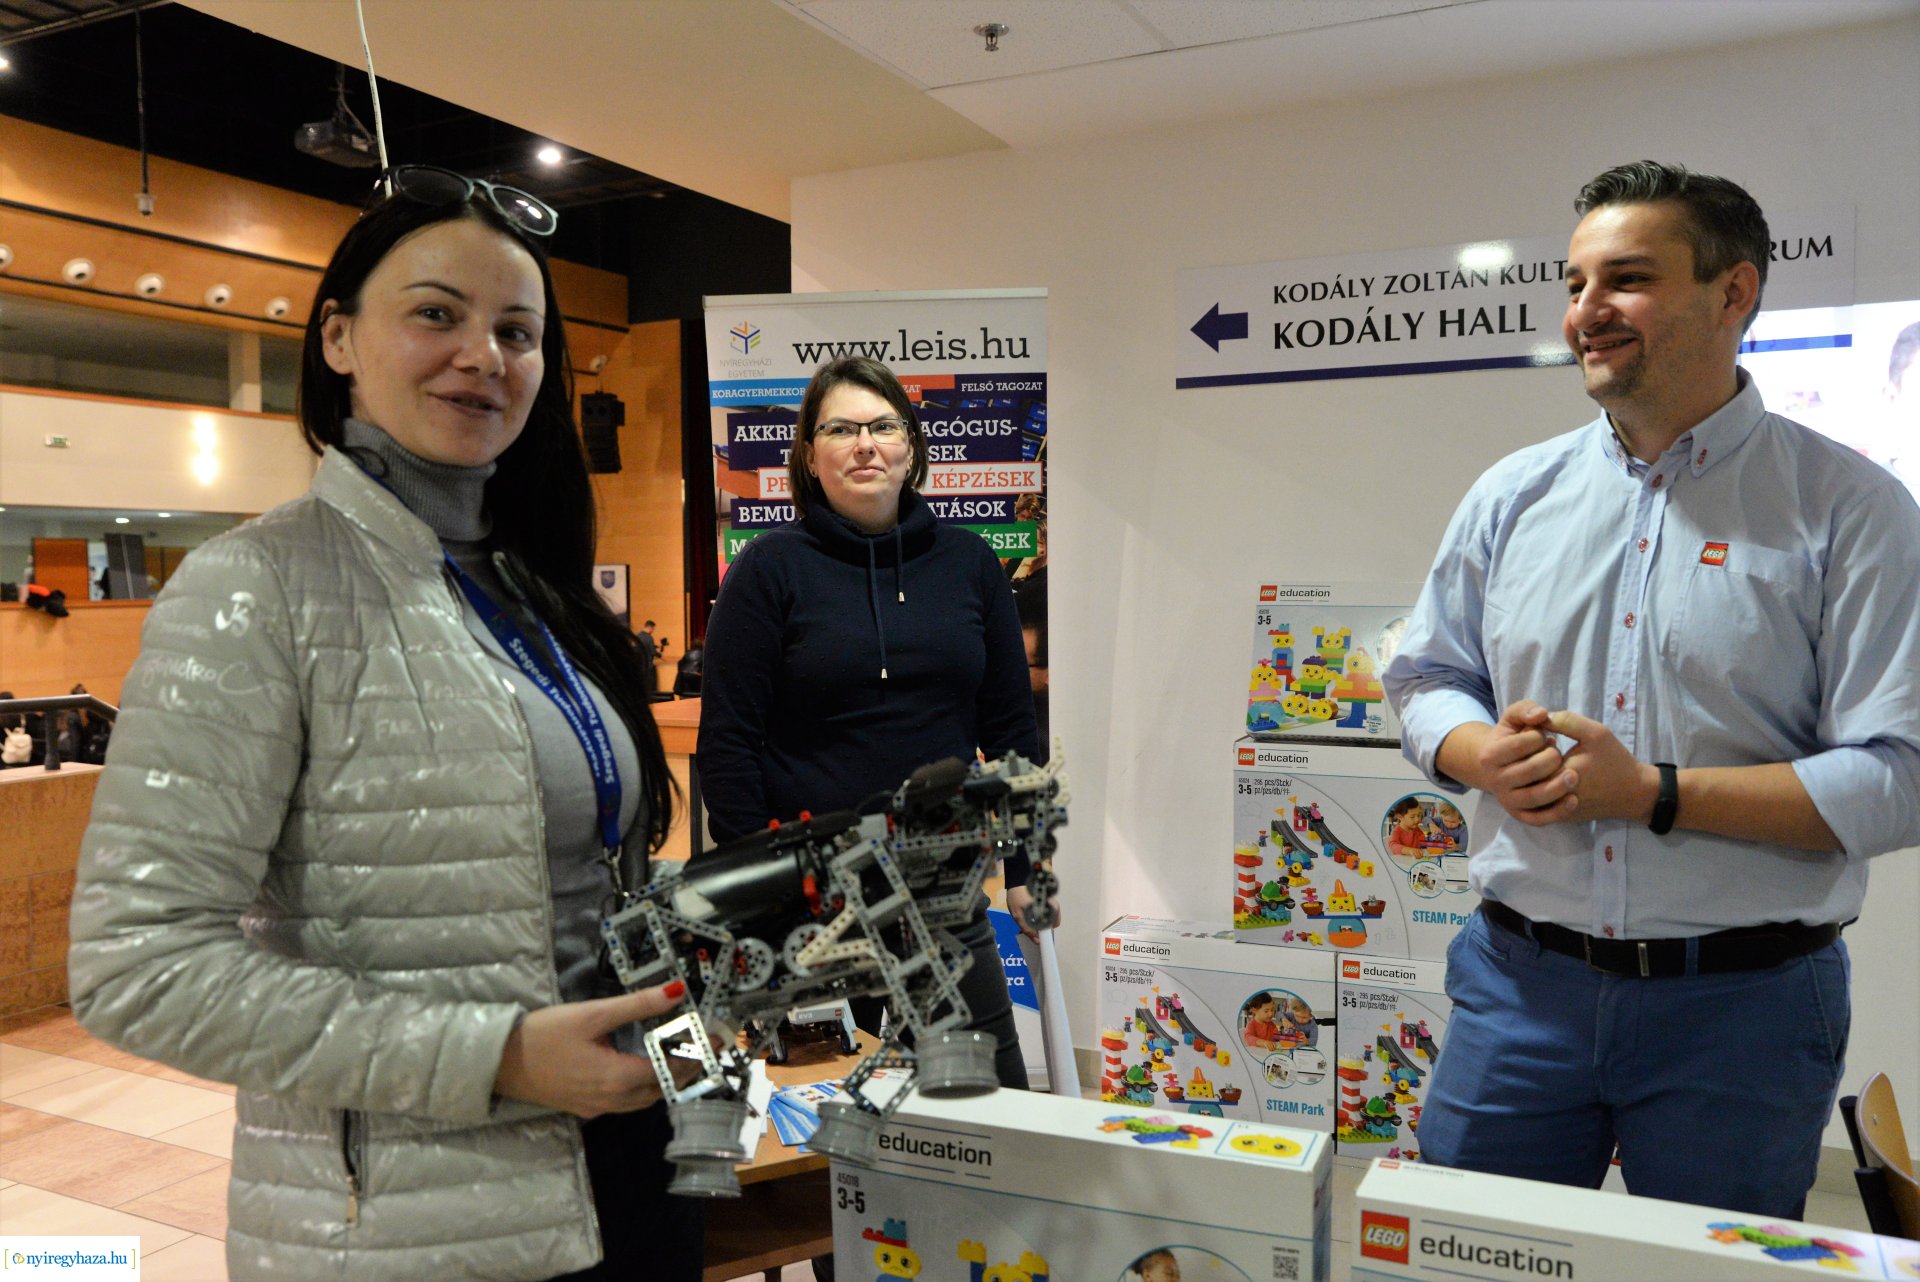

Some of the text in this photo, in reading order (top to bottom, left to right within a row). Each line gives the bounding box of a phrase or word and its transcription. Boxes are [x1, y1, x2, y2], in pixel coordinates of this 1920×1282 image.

[1273, 234, 1834, 304] KODÁLY ZOLTÁN KULT RUM
[1273, 303, 1537, 350] KODÁLY HALL
[792, 327, 1030, 364] www.leis.hu
[728, 369, 765, 378] EGYETEM
[902, 384, 921, 393] ZAT
[961, 380, 1043, 392] FELSŐ TAGOZAT
[734, 415, 1018, 442] AKKRE AGÓGUS-
[928, 444, 968, 461] SEK
[931, 467, 1036, 489] KÉPZÉSEK
[738, 497, 1007, 522] BEMU ATÁSOK
[979, 529, 1031, 550] ÉSEK
[1280, 588, 1331, 597] education
[1257, 615, 1272, 625] 3-5
[508, 637, 551, 688] Szegedi
[1258, 753, 1309, 763] education
[1238, 784, 1252, 795] 3-5
[1412, 910, 1447, 925] STEAM
[1123, 943, 1171, 956] education
[1105, 971, 1118, 982] 3-5
[1363, 966, 1416, 980] education
[1342, 996, 1357, 1008] 3-5
[1266, 1098, 1325, 1117] STEAM Park
[878, 1132, 992, 1166] education
[837, 1187, 866, 1214] 3-5
[1365, 1226, 1574, 1279] LEGO education
